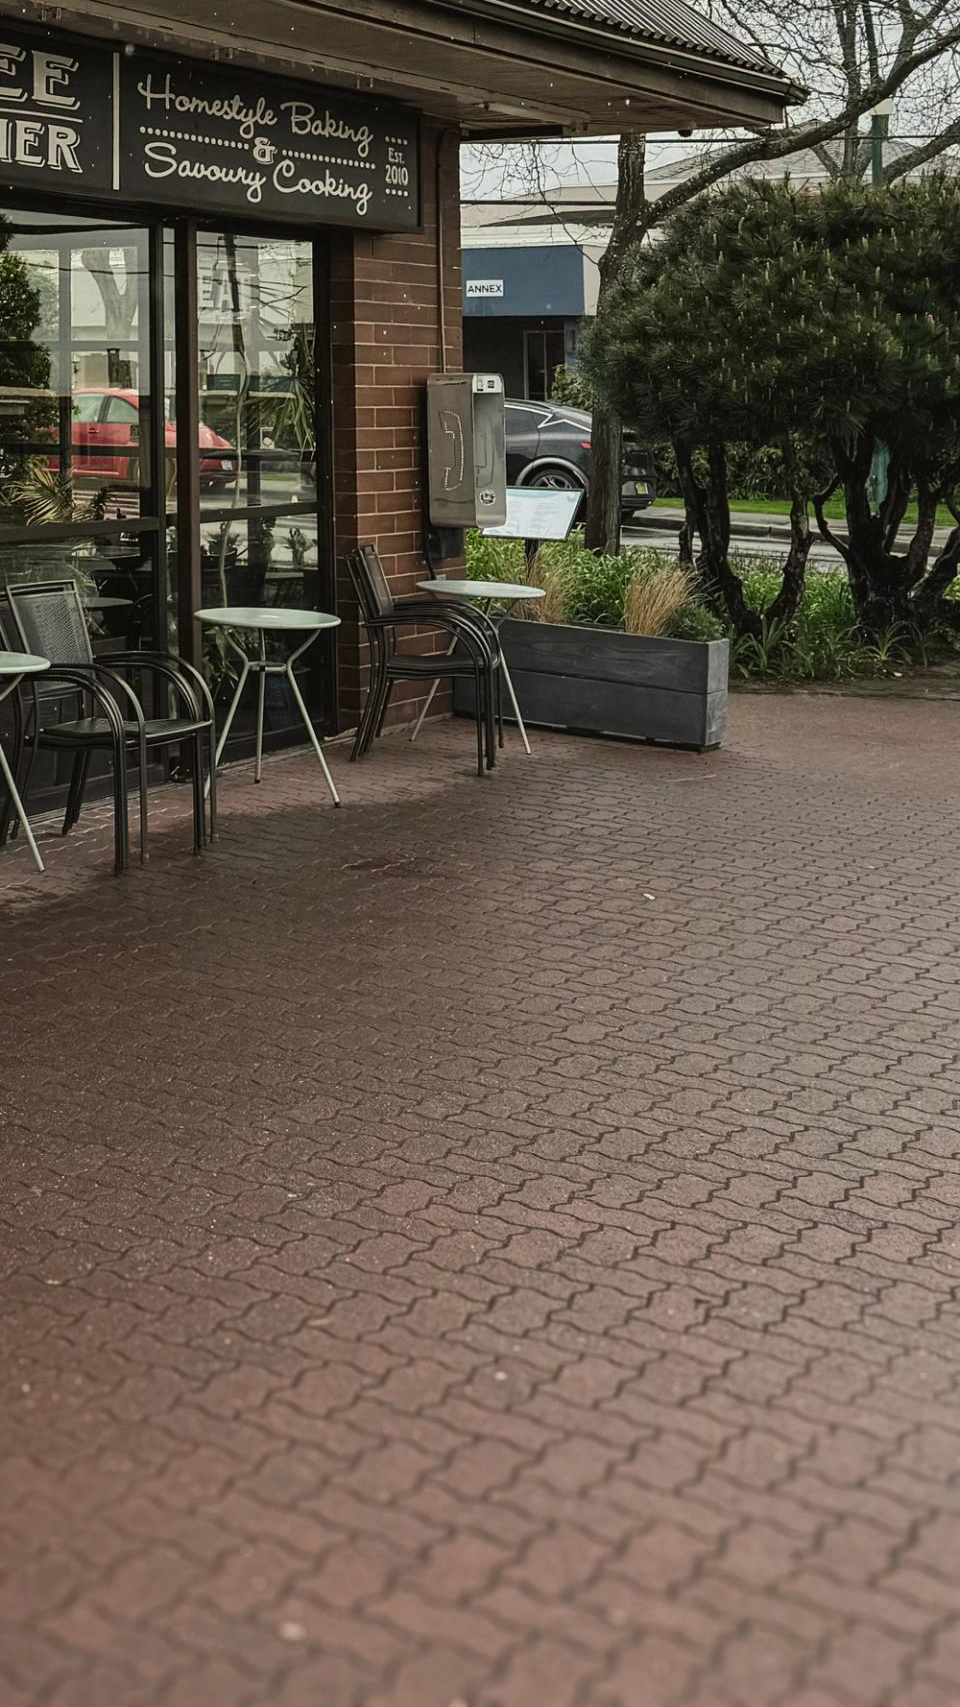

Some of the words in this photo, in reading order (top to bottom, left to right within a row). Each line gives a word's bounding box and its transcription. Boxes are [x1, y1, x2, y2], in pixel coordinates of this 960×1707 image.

[137, 73, 278, 139] Homestyle
[280, 101, 374, 158] Baking
[253, 136, 278, 165] &
[144, 142, 267, 203] Savoury
[273, 159, 373, 216] Cooking
[385, 164, 409, 186] 2010
[468, 284, 502, 293] ANNEX
